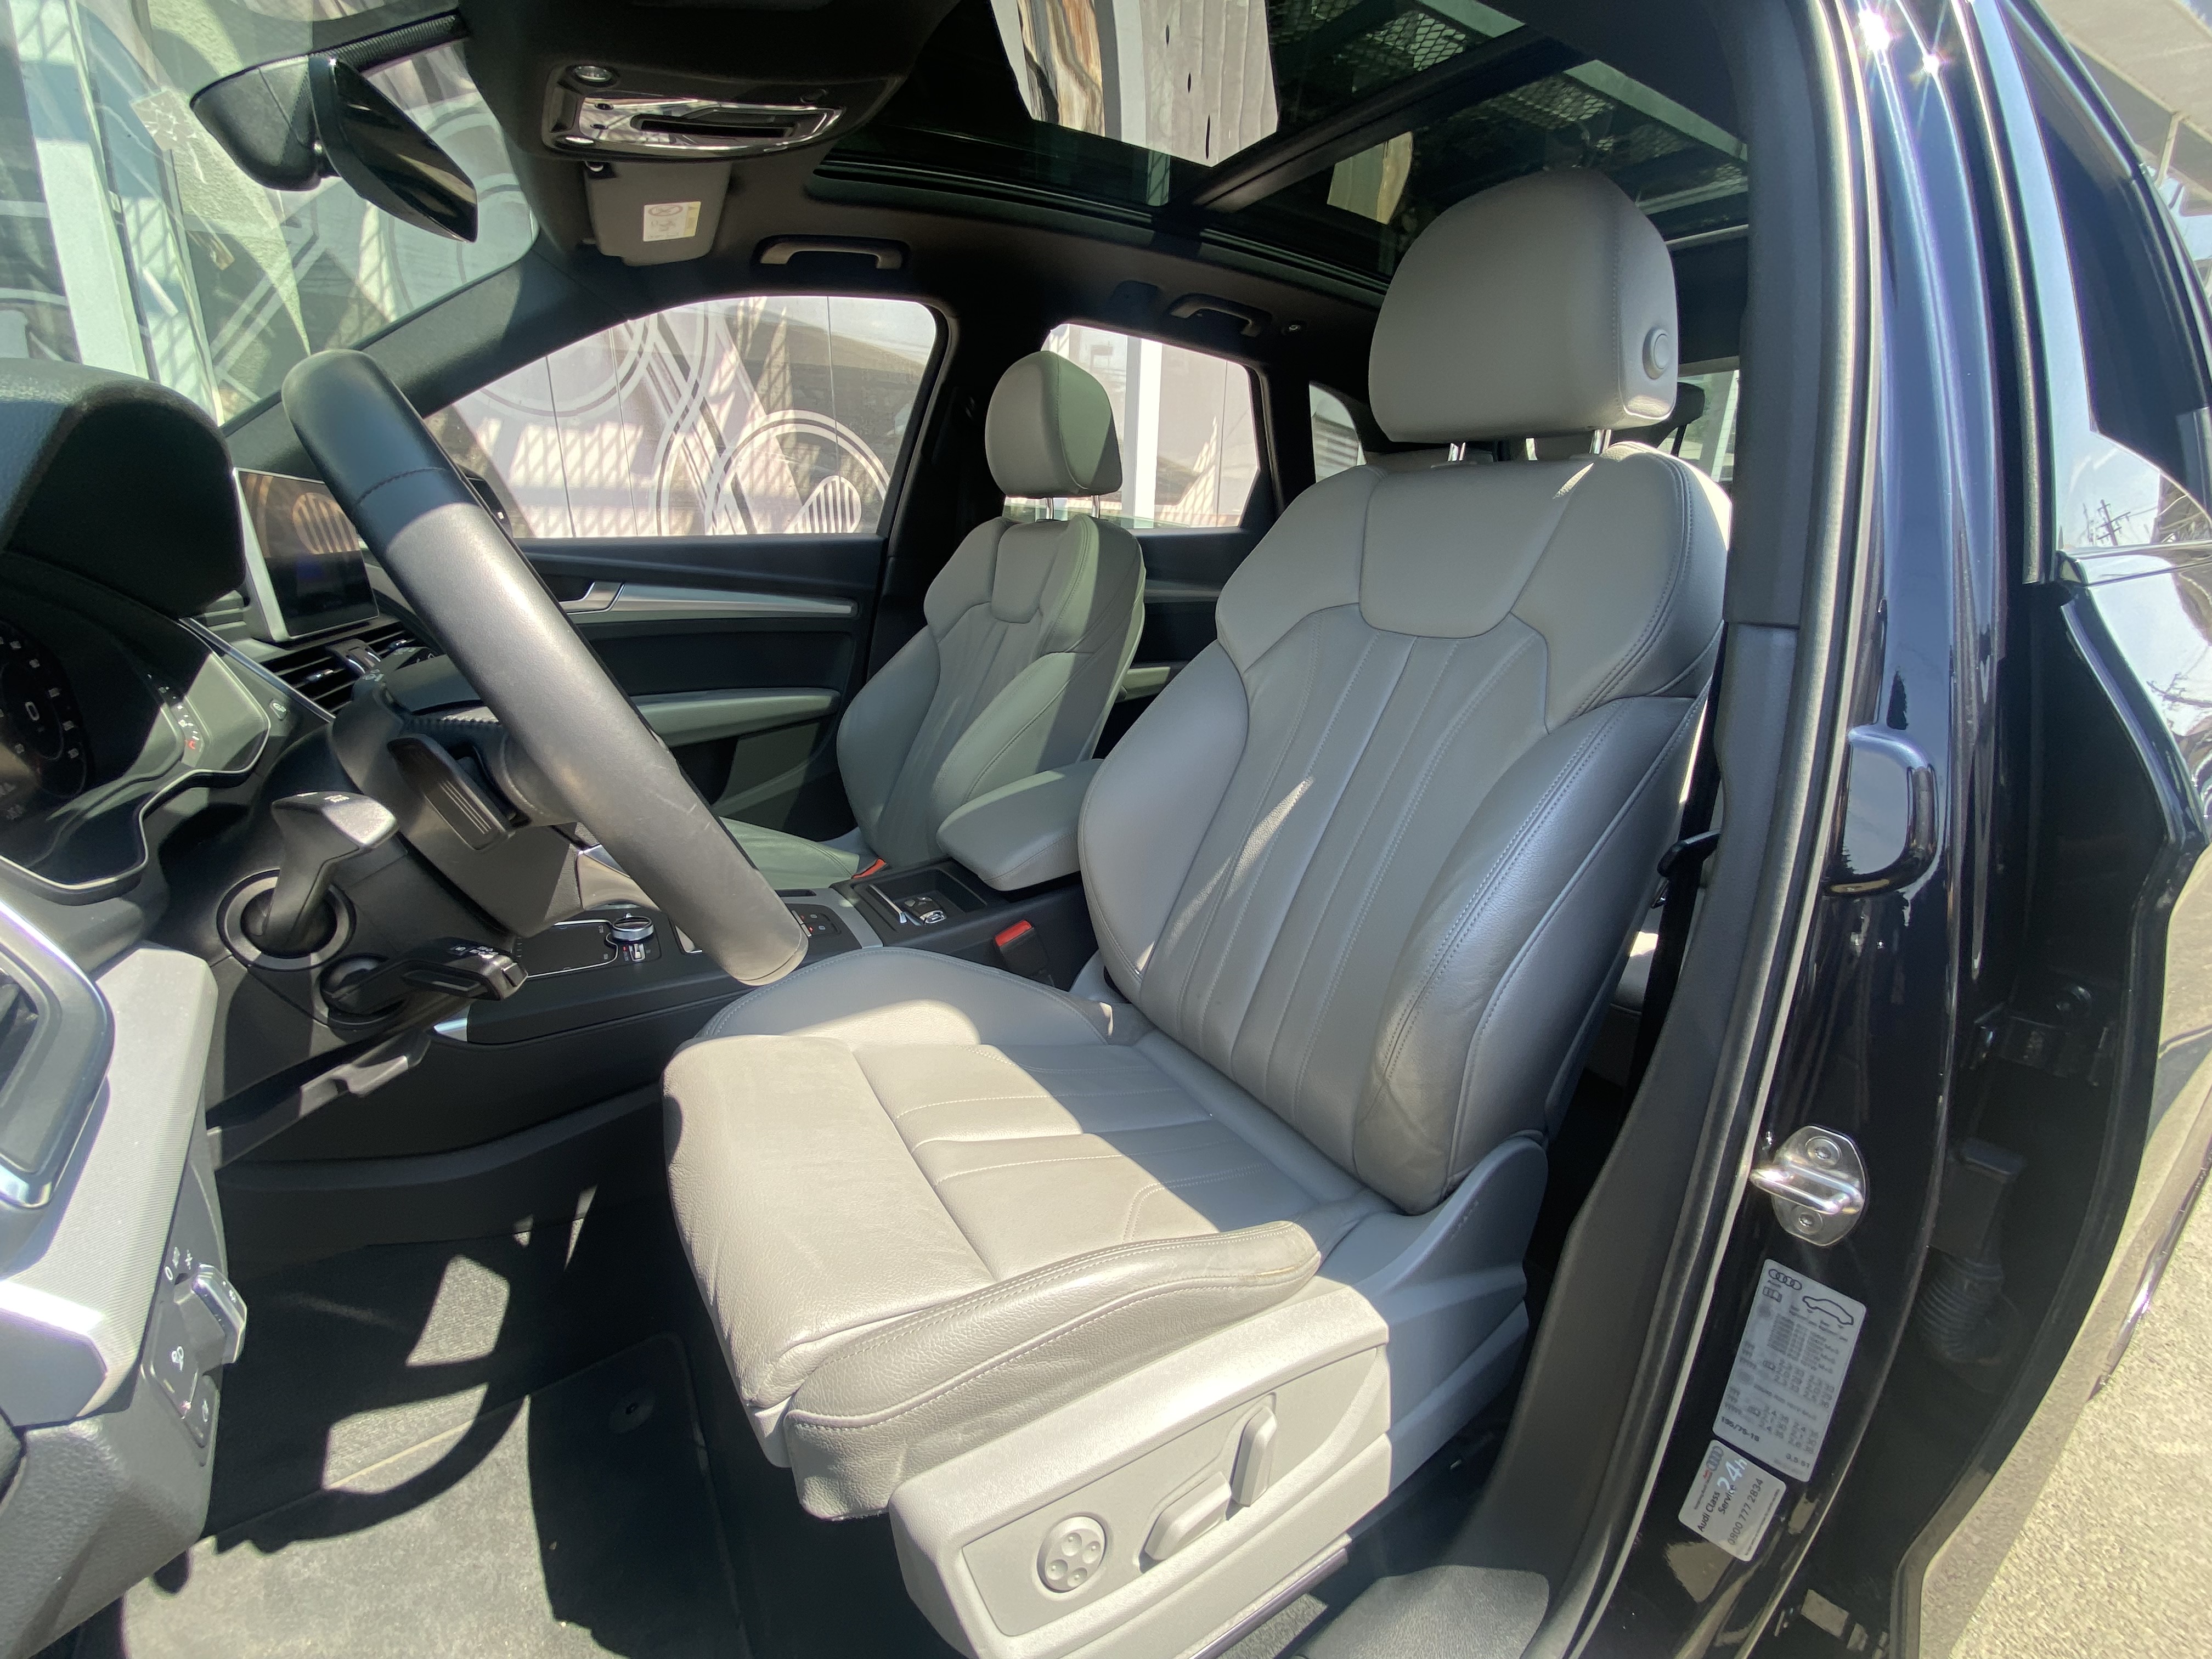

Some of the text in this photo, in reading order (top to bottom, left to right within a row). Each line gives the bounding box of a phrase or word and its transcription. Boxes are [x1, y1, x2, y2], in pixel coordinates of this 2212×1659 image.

[1717, 1458, 1747, 1494] 24h
[1697, 1513, 1710, 1532] Audi
[1706, 1491, 1720, 1513] Class
[1718, 1484, 1737, 1515] Service
[1728, 1478, 1763, 1545] 0800 777 2834
